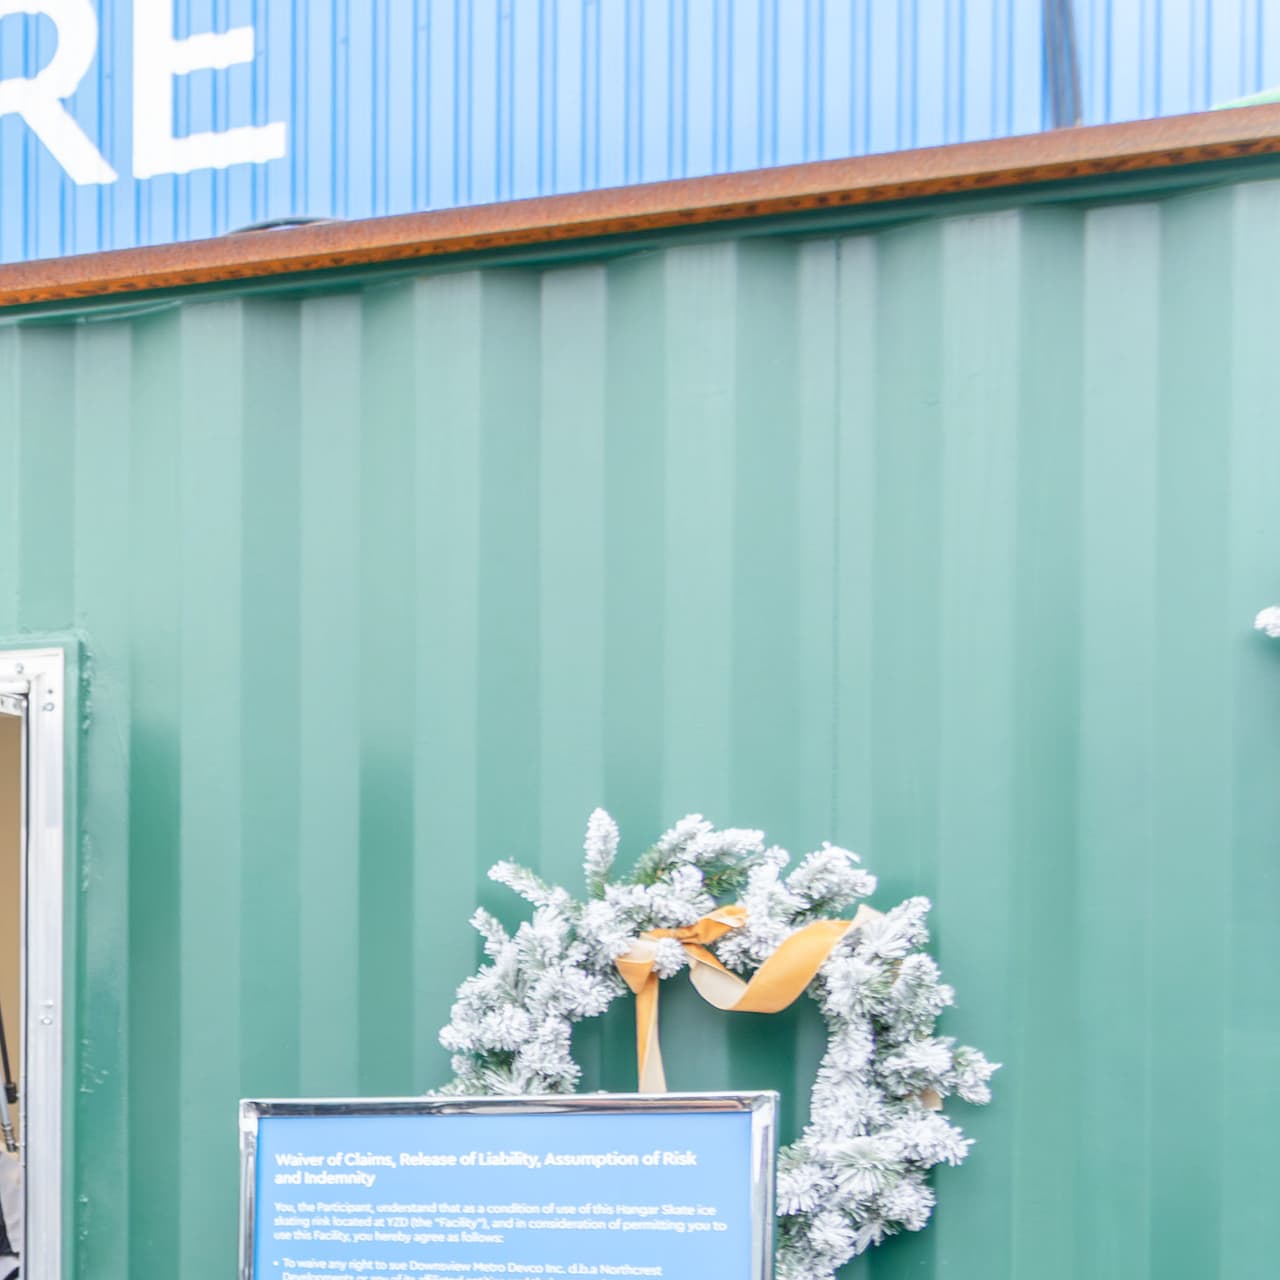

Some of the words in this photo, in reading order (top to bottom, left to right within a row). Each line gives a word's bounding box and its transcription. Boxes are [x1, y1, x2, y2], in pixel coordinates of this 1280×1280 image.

[275, 1153, 324, 1166] Waiver
[327, 1152, 343, 1166] of
[344, 1152, 396, 1168] Claims,
[400, 1152, 457, 1166] Release
[460, 1152, 476, 1165] of
[478, 1152, 541, 1168] Liability,
[544, 1151, 639, 1168] Assumption
[642, 1151, 661, 1165] of
[663, 1151, 696, 1165] Risk
[275, 1170, 301, 1184] and
[304, 1170, 376, 1187] Indemnity
